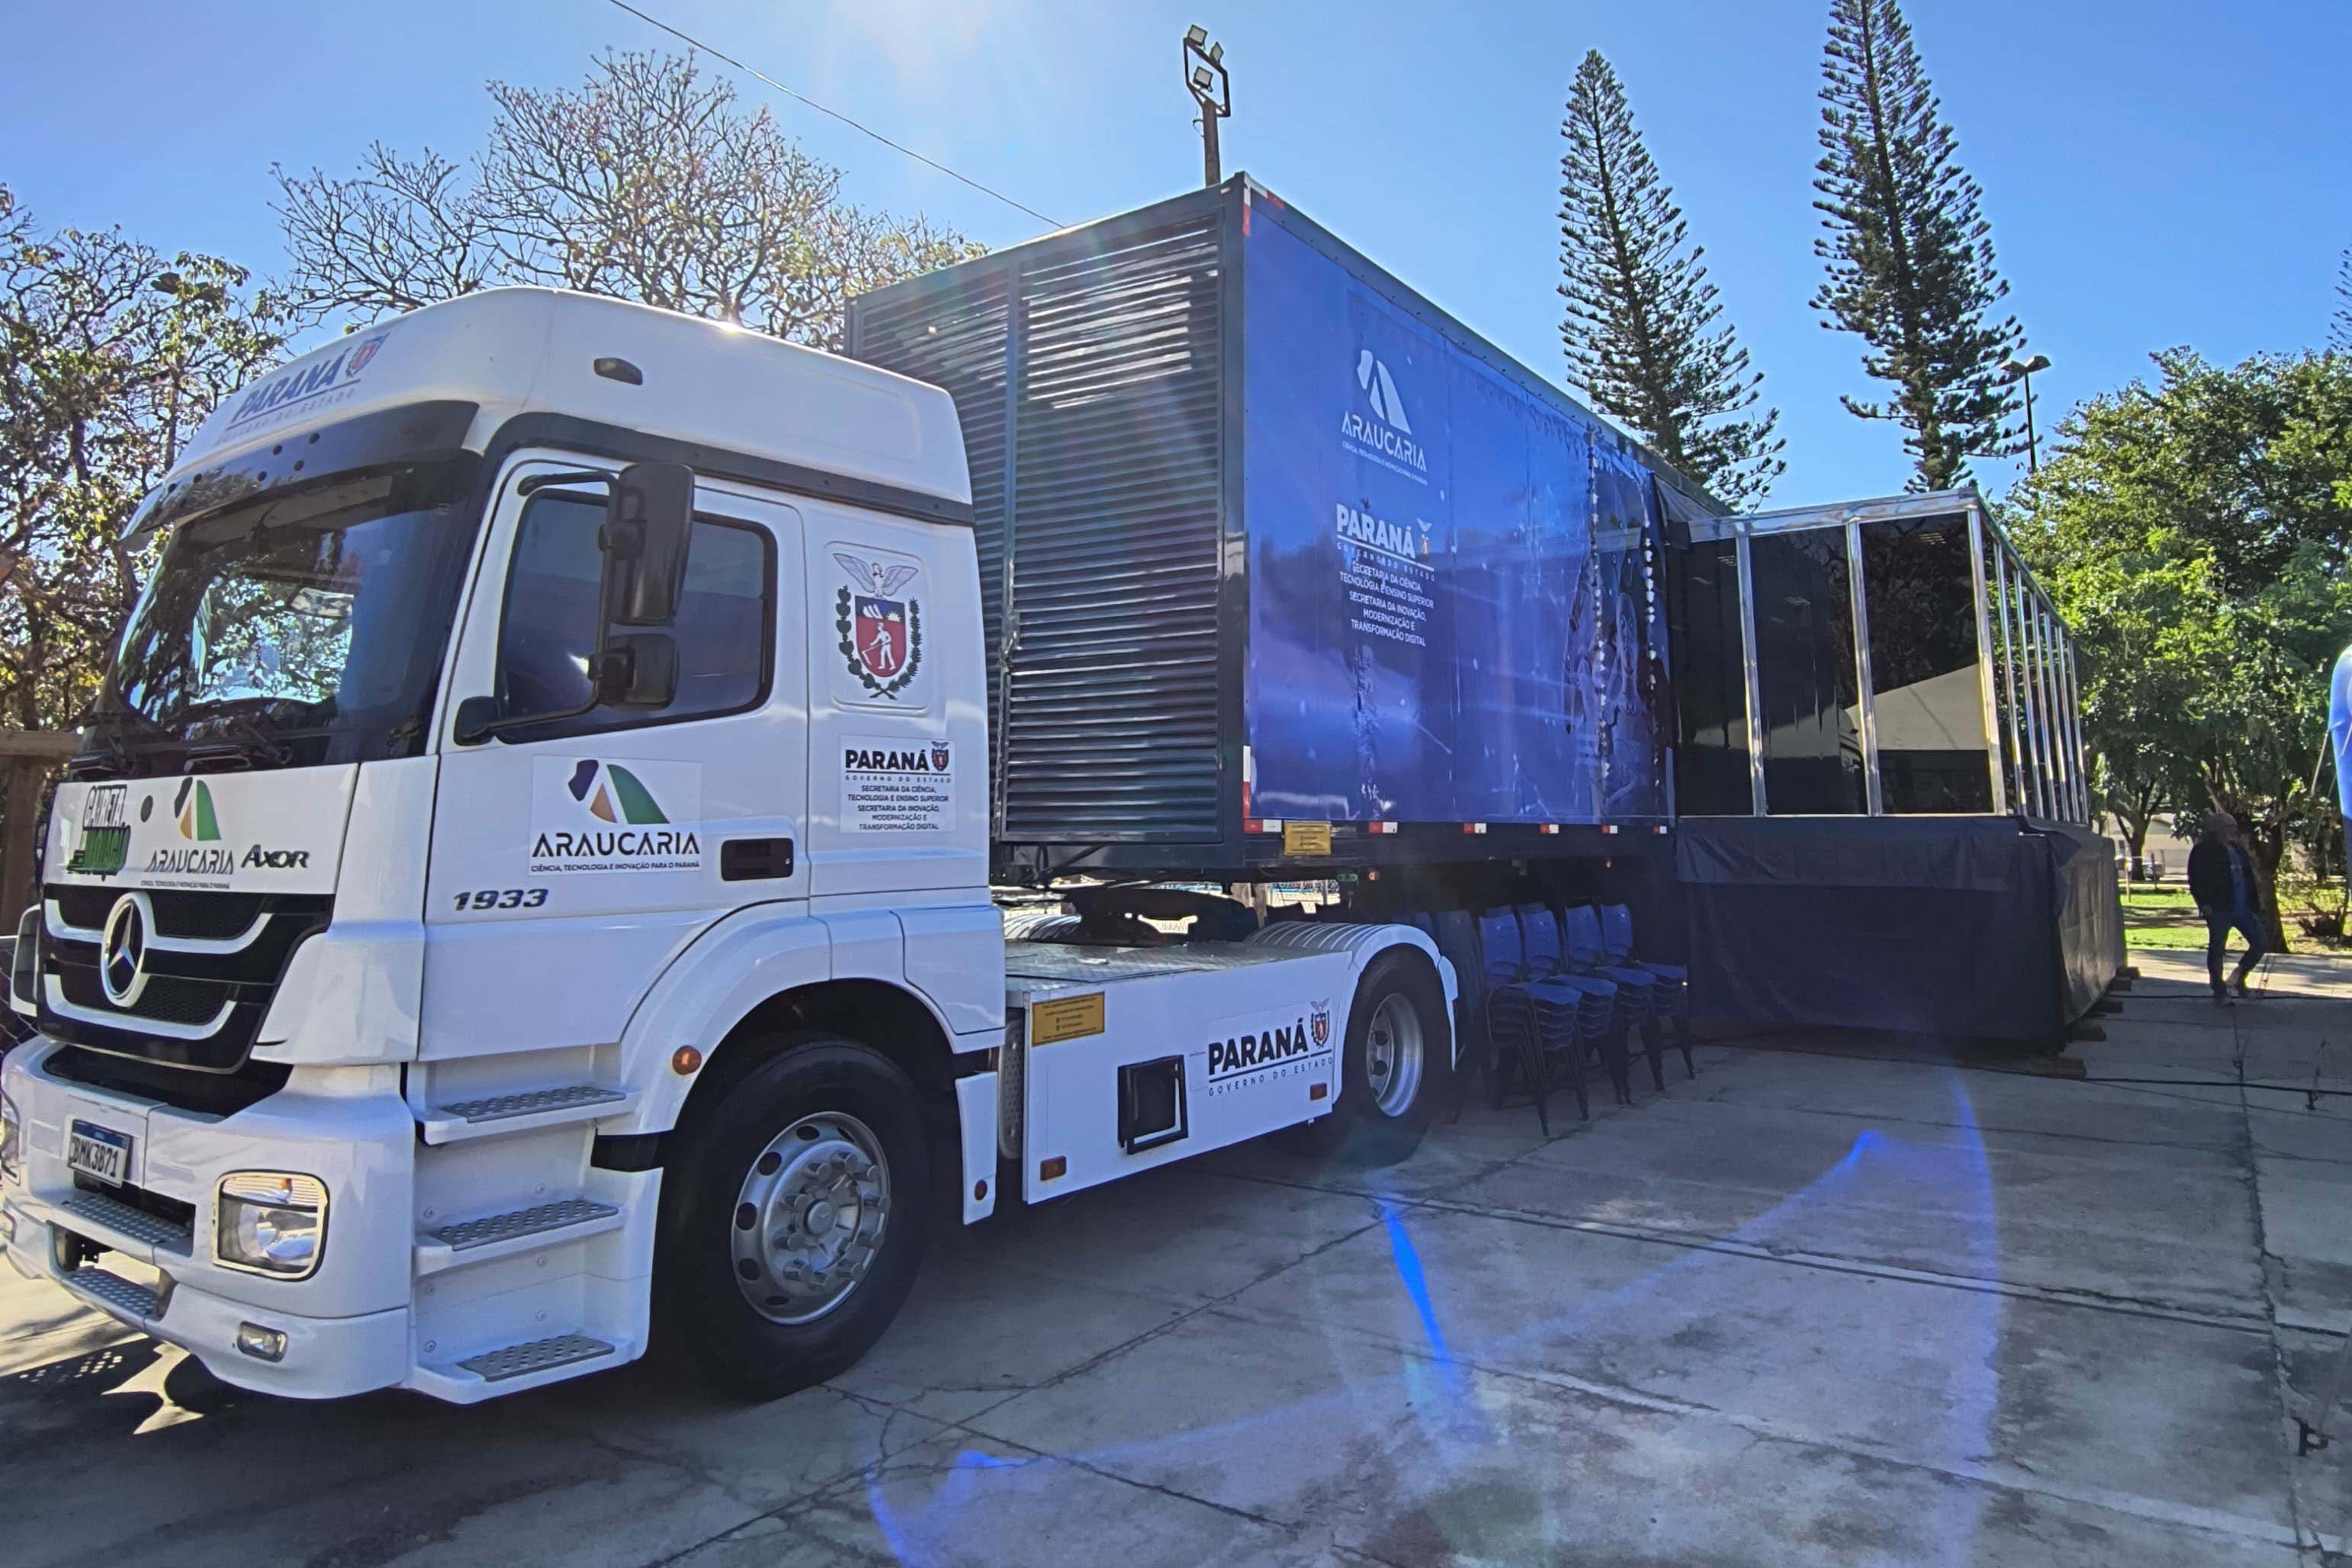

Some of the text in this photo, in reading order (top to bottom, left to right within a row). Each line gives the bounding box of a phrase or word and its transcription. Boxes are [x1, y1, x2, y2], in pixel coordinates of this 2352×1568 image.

[231, 347, 353, 423] PARANÁ
[1341, 410, 1428, 472] ARAUCARIA
[1336, 503, 1415, 558] PARANÁ
[1353, 564, 1423, 593] SECRETARIA DA CIÊNCIA,
[1404, 565, 1435, 581] ESTADO
[1340, 572, 1379, 592] TECNOLOGIA
[1386, 586, 1406, 599] ENSINO
[1408, 593, 1434, 609] SUPERIOR
[1349, 591, 1426, 622] SECRETARIA DA INOVAÇÃO,
[1364, 609, 1415, 631] MODERNIZAÇÃO E
[1351, 619, 1426, 647] TRANSFORMAÇÃO DIGITAL
[845, 749, 929, 771] PARANÁ
[859, 822, 915, 831] TRANSFORMAÇÃO
[532, 831, 700, 857] ARAUCARIA
[143, 849, 233, 875] ARAUCARIA
[531, 863, 563, 872] CIÊNCIA,
[564, 863, 608, 871] TECNOLOGIA
[615, 861, 649, 870] INOVAÇÃO
[453, 888, 549, 911] 1933
[1208, 1017, 1309, 1075] PARANÁ
[1209, 1056, 1333, 1097] GOVERNO DO ESTADO
